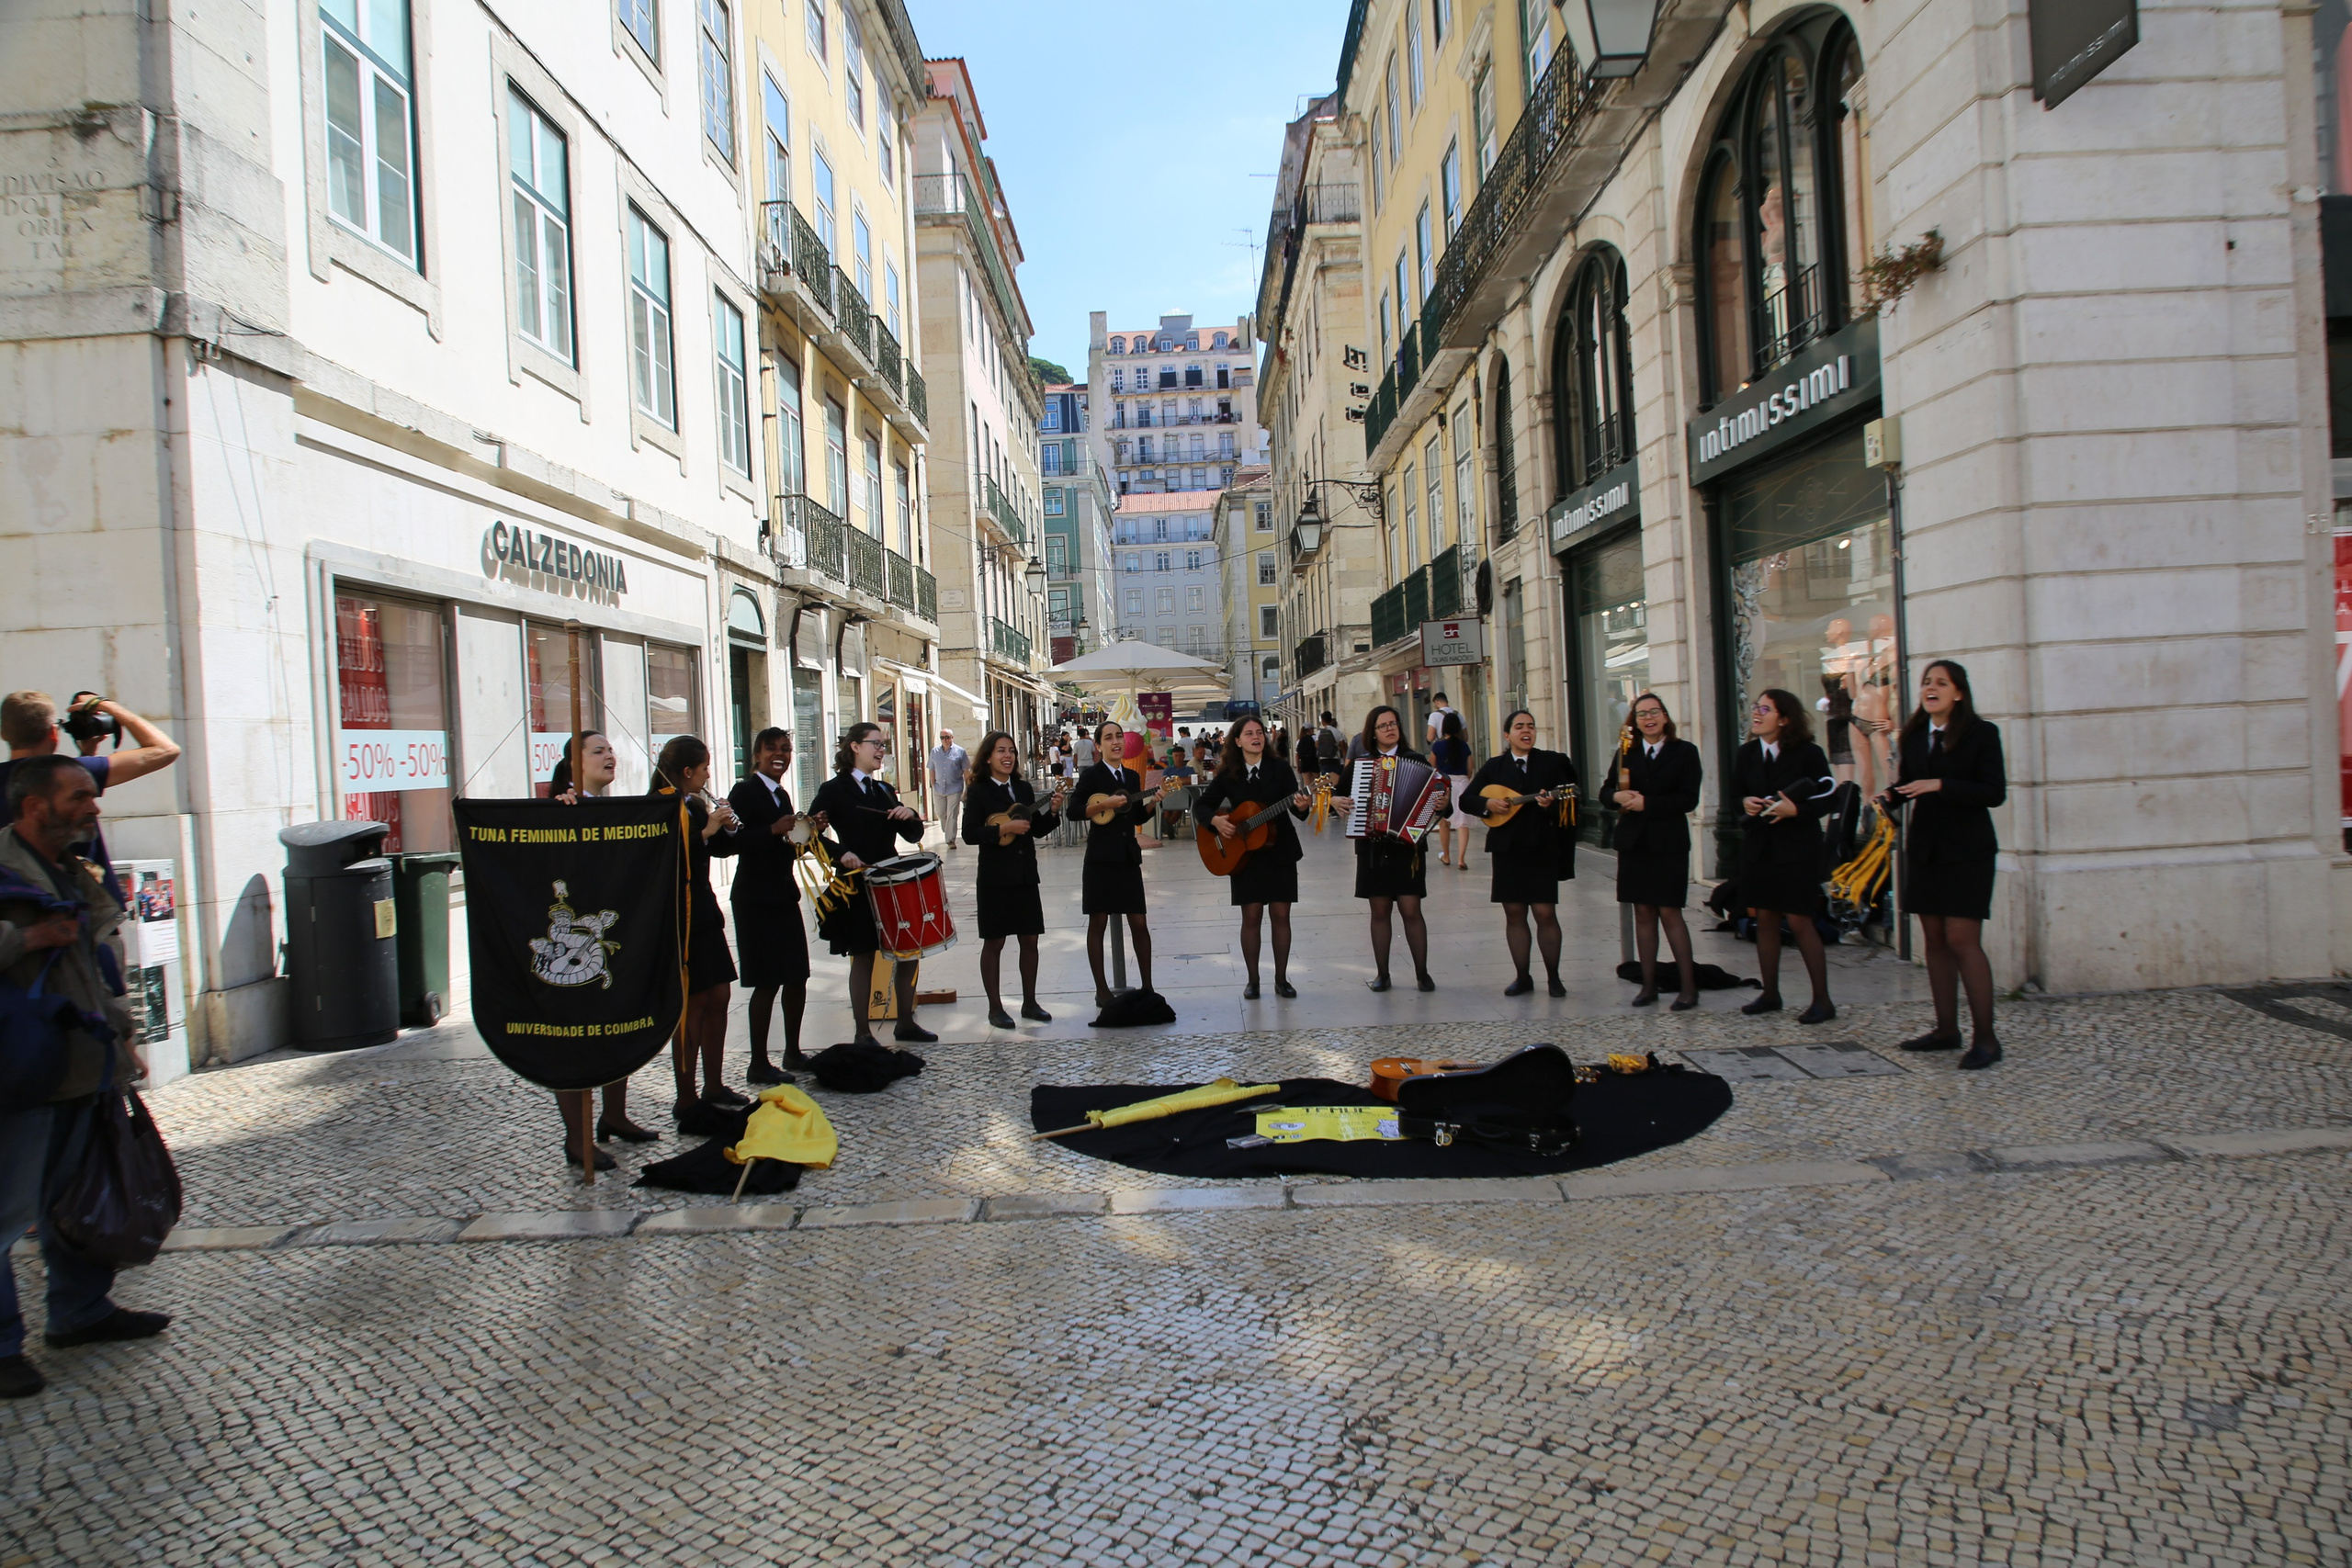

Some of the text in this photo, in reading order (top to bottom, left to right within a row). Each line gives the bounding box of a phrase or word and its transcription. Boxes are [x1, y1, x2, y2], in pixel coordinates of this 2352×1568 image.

[1700, 355, 1849, 463] intimissimi
[1553, 481, 1629, 541] intimissimi
[492, 520, 628, 595] CALZEDONIA
[1431, 642, 1474, 655] HOTEL
[1450, 654, 1475, 662] NAÇÕES
[342, 743, 447, 780] -50% -50%
[469, 822, 669, 843] TUNA FEMININA DE MEDICINA
[506, 1016, 655, 1037] UNIVERSIDADE DE COIMBRA
